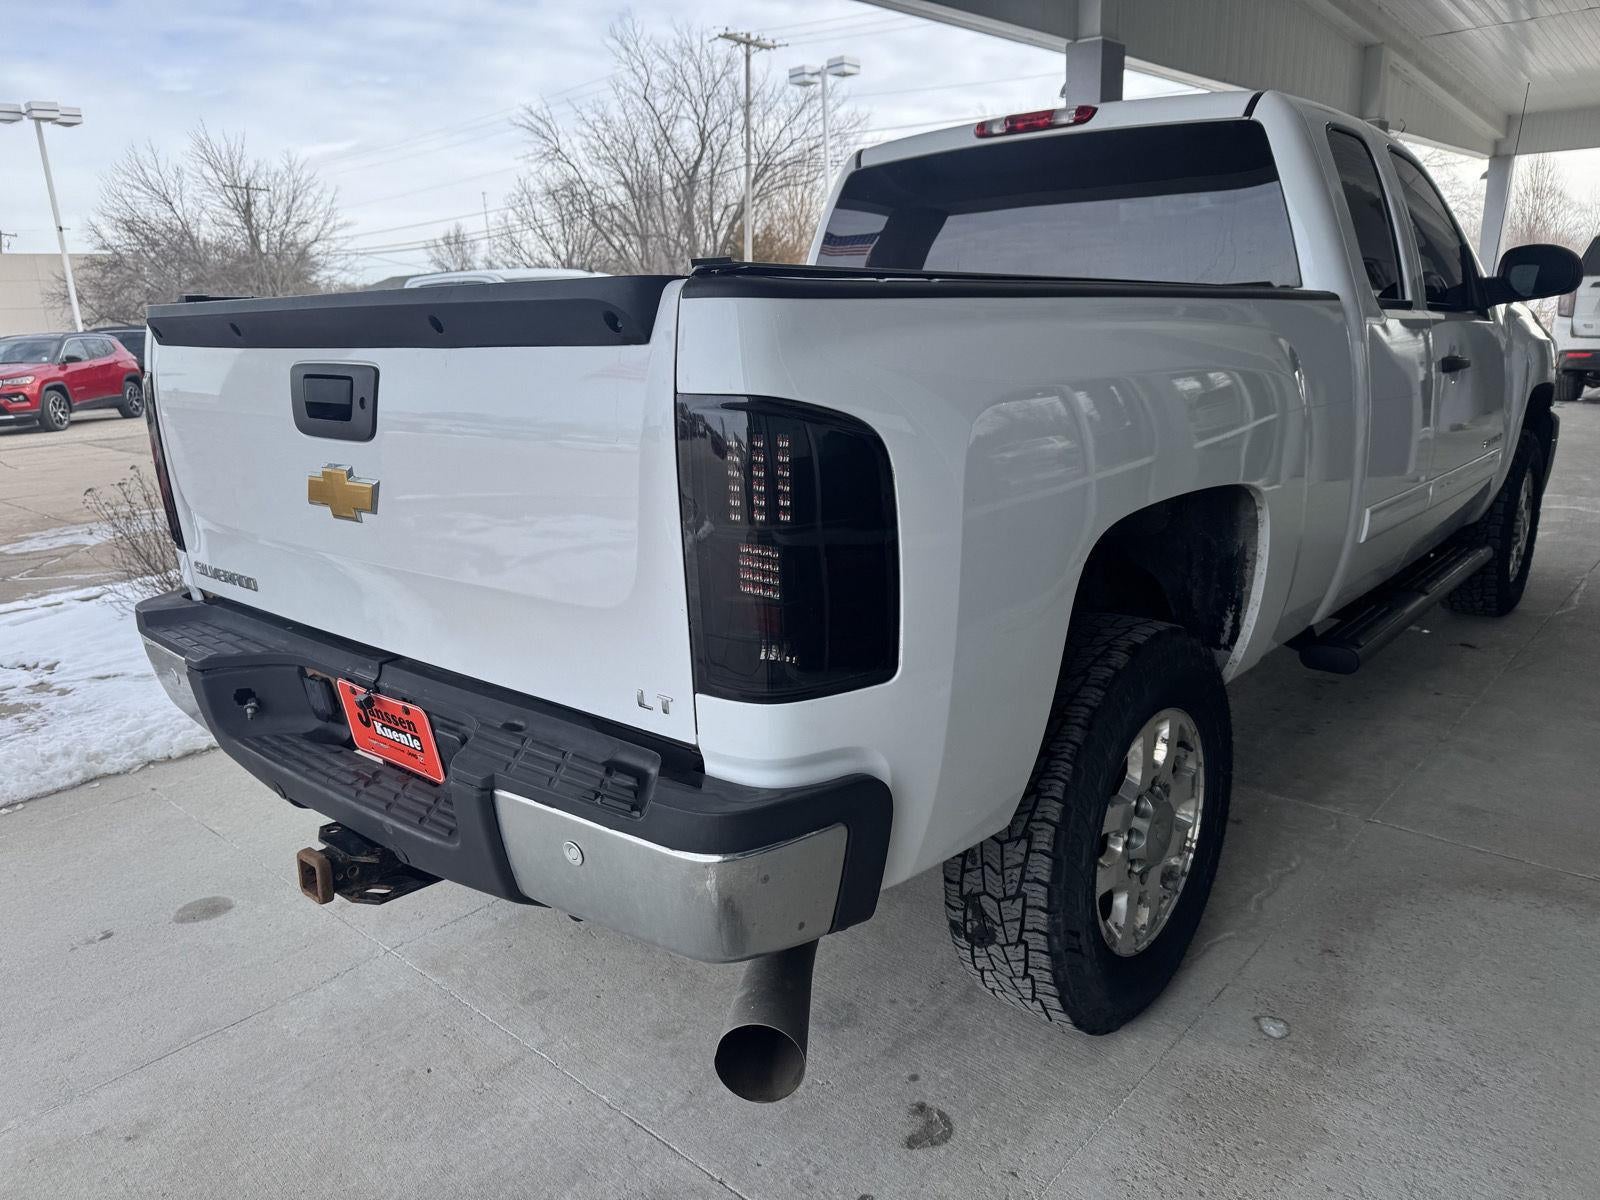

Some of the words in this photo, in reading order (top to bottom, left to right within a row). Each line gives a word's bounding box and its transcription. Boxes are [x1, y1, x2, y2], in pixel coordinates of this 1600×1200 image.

[194, 561, 258, 592] SILVERADO
[637, 688, 674, 714] LT
[355, 700, 418, 734] Janssen
[373, 720, 421, 750] Kuenle
